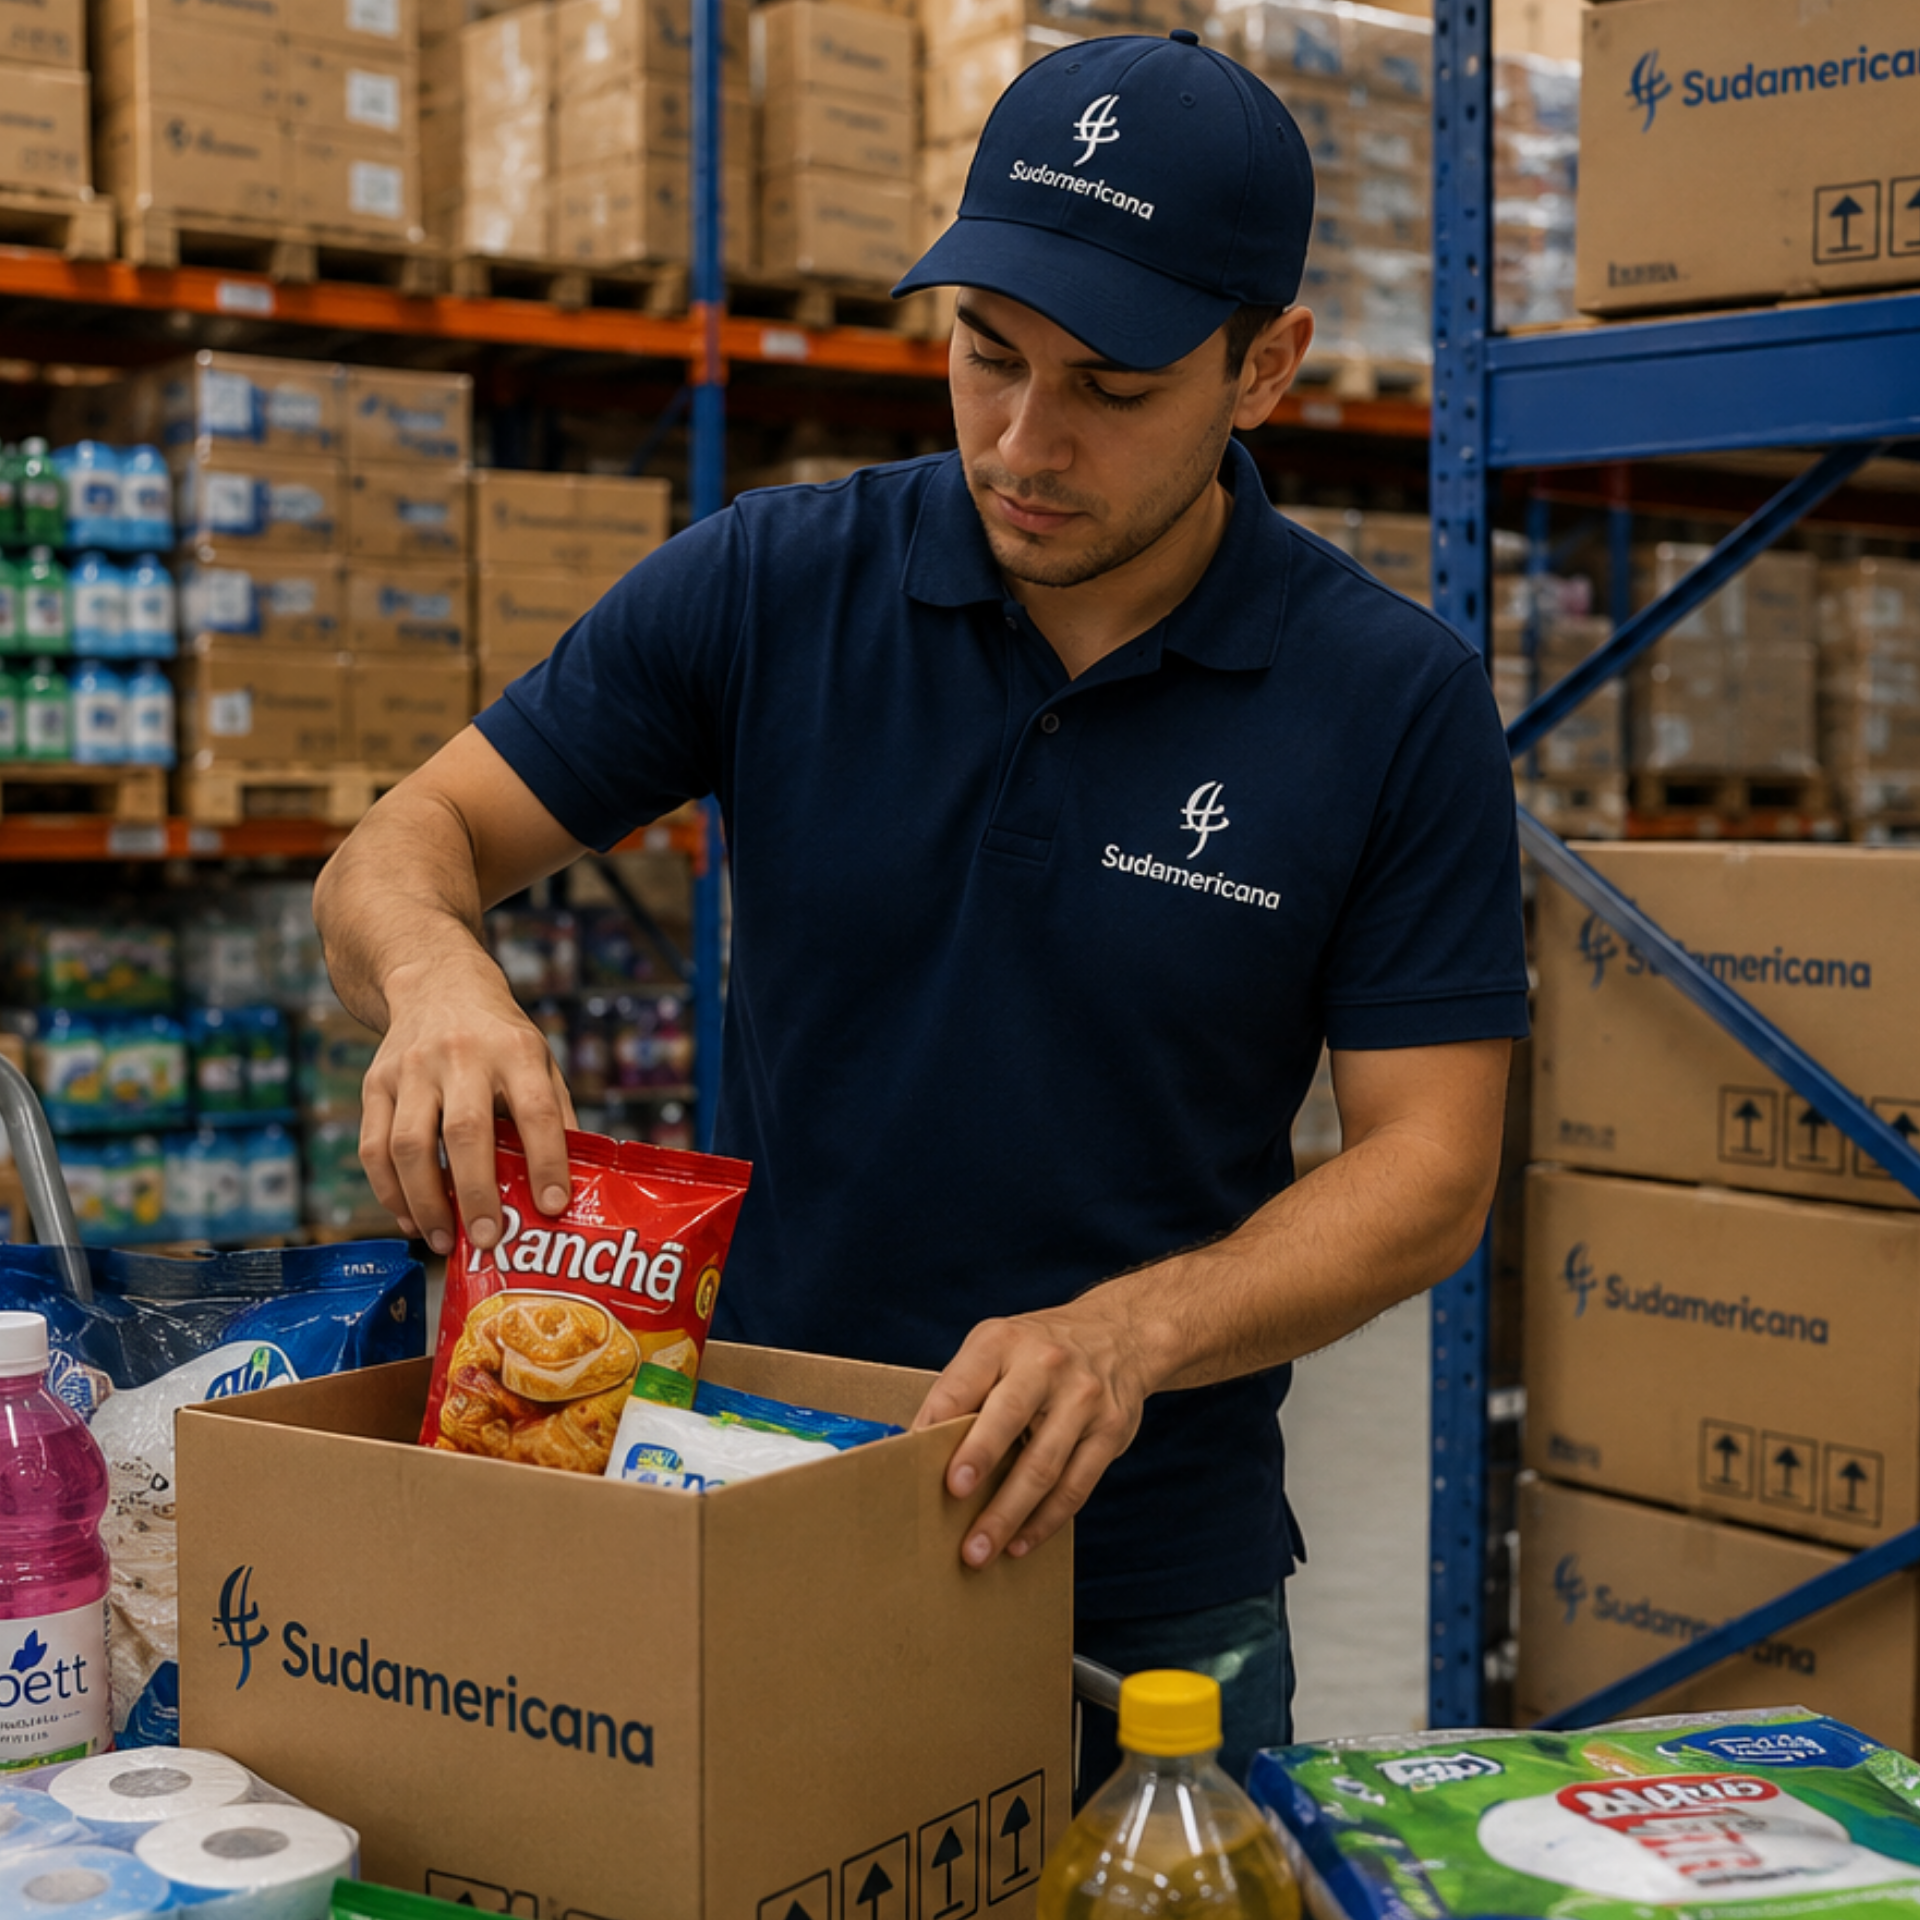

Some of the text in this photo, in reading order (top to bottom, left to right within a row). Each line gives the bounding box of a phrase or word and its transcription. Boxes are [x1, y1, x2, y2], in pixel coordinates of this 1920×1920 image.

[1682, 45, 1920, 107] Sudamerica
[1009, 160, 1155, 220] Sudamericana
[1101, 844, 1281, 910] Sudamericana
[1604, 1274, 1829, 1345] Sudamericana
[282, 1621, 654, 1768] Sudamericana
